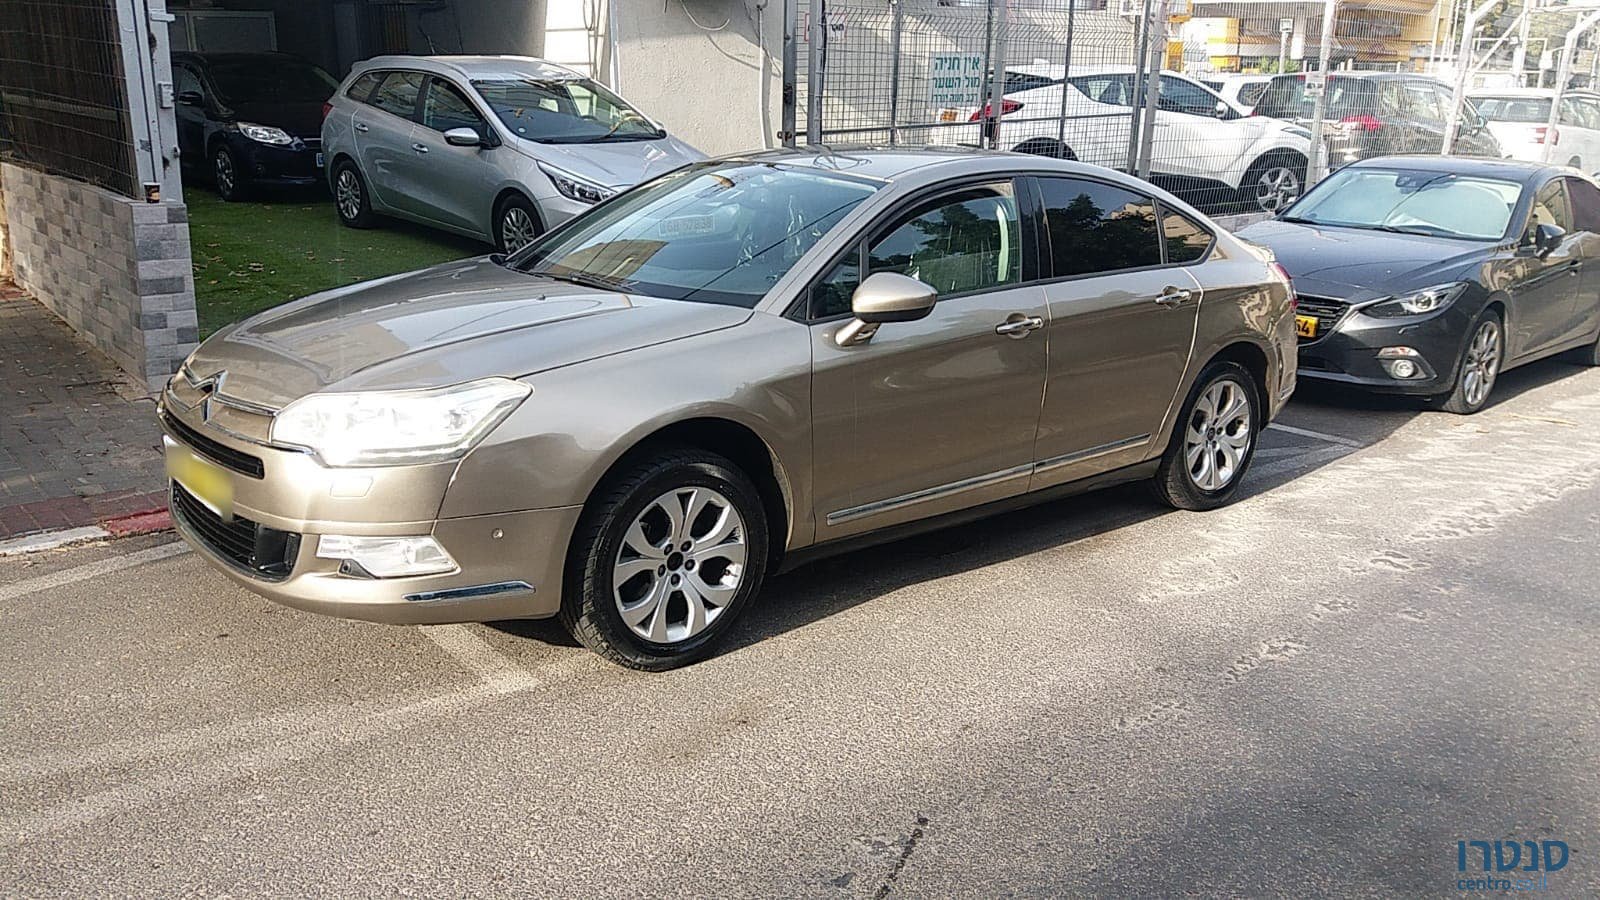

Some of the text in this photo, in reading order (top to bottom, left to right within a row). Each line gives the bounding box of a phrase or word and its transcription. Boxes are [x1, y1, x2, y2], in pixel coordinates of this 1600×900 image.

[935, 57, 979, 74] אין חניה
[933, 75, 980, 88] מול השער
